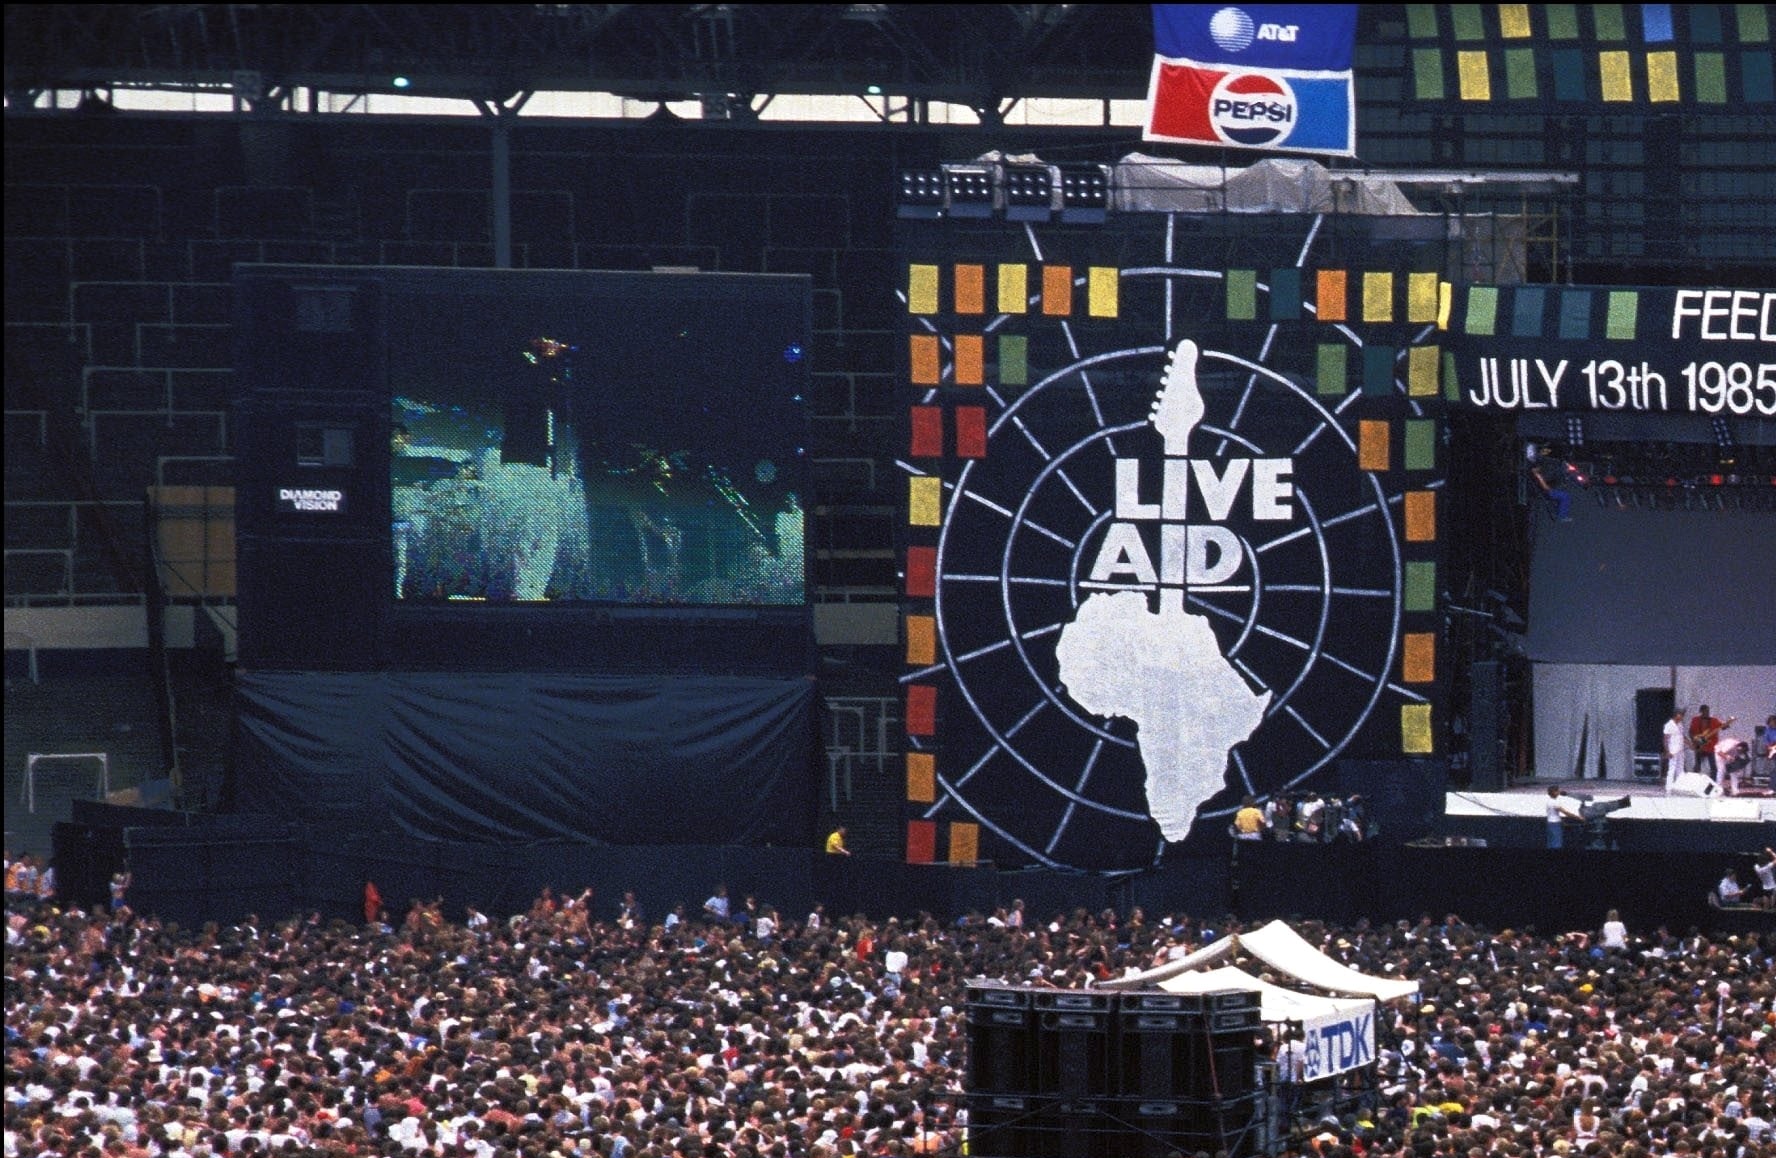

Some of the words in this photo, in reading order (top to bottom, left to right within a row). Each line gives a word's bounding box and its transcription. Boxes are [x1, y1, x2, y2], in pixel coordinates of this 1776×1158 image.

[1257, 23, 1299, 42] AT&T
[1213, 98, 1292, 123] PEPSI
[1469, 357, 1569, 409] JULY
[1581, 360, 1667, 411] 13th
[280, 489, 342, 501] DIAMOND
[293, 500, 338, 511] VISION
[1115, 458, 1293, 520] LIVE
[1089, 523, 1243, 584] AID
[1321, 1013, 1371, 1073] TDK
